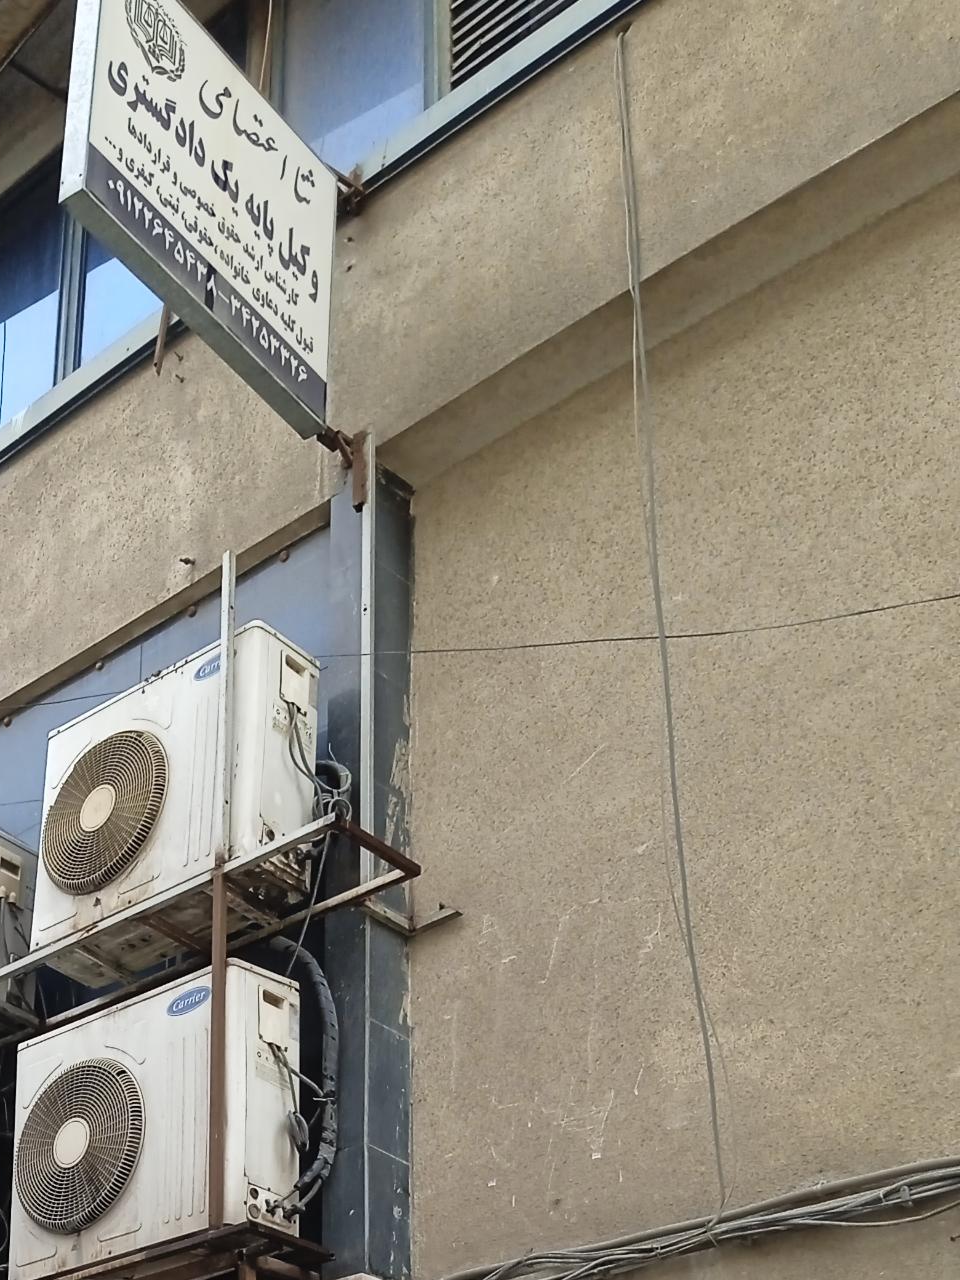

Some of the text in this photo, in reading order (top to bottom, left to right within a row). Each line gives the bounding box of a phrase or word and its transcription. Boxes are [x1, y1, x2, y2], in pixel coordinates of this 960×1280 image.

[108, 60, 205, 168] دادگستری
[125, 156, 155, 188] کیفری
[210, 159, 239, 217] یک
[127, 117, 300, 307] کارشناس ارشد حقوق خصوصی و قراردادها
[245, 193, 274, 257] پایه
[278, 227, 320, 304] وکیل
[252, 286, 279, 317] دعاوی
[280, 310, 296, 334] کلیه
[295, 326, 314, 354] قبول
[172, 990, 206, 1012] Carrier
